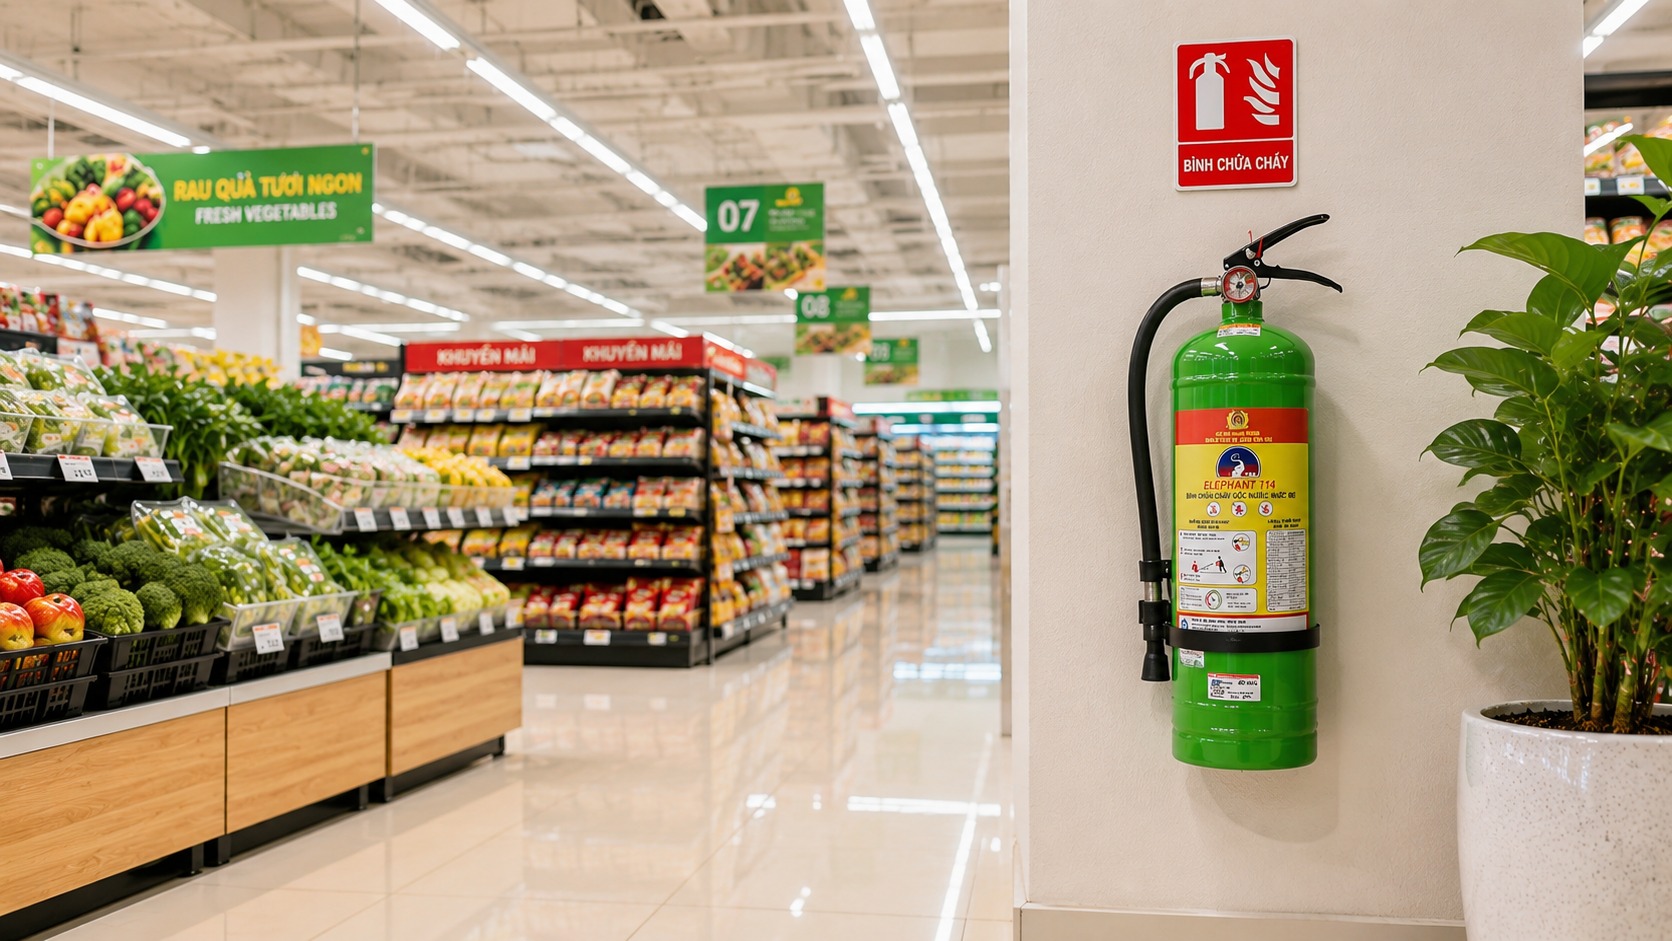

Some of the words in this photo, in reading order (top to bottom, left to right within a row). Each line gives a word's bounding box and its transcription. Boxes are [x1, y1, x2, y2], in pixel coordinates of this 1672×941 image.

[1183, 156, 1213, 172] BÌNH
[173, 179, 212, 202] RAU
[307, 172, 362, 196] NGON
[195, 206, 242, 225] FRESH
[244, 201, 338, 223] VEGETABLES
[717, 199, 760, 232] 07
[1203, 480, 1256, 490] ELEPHANT
